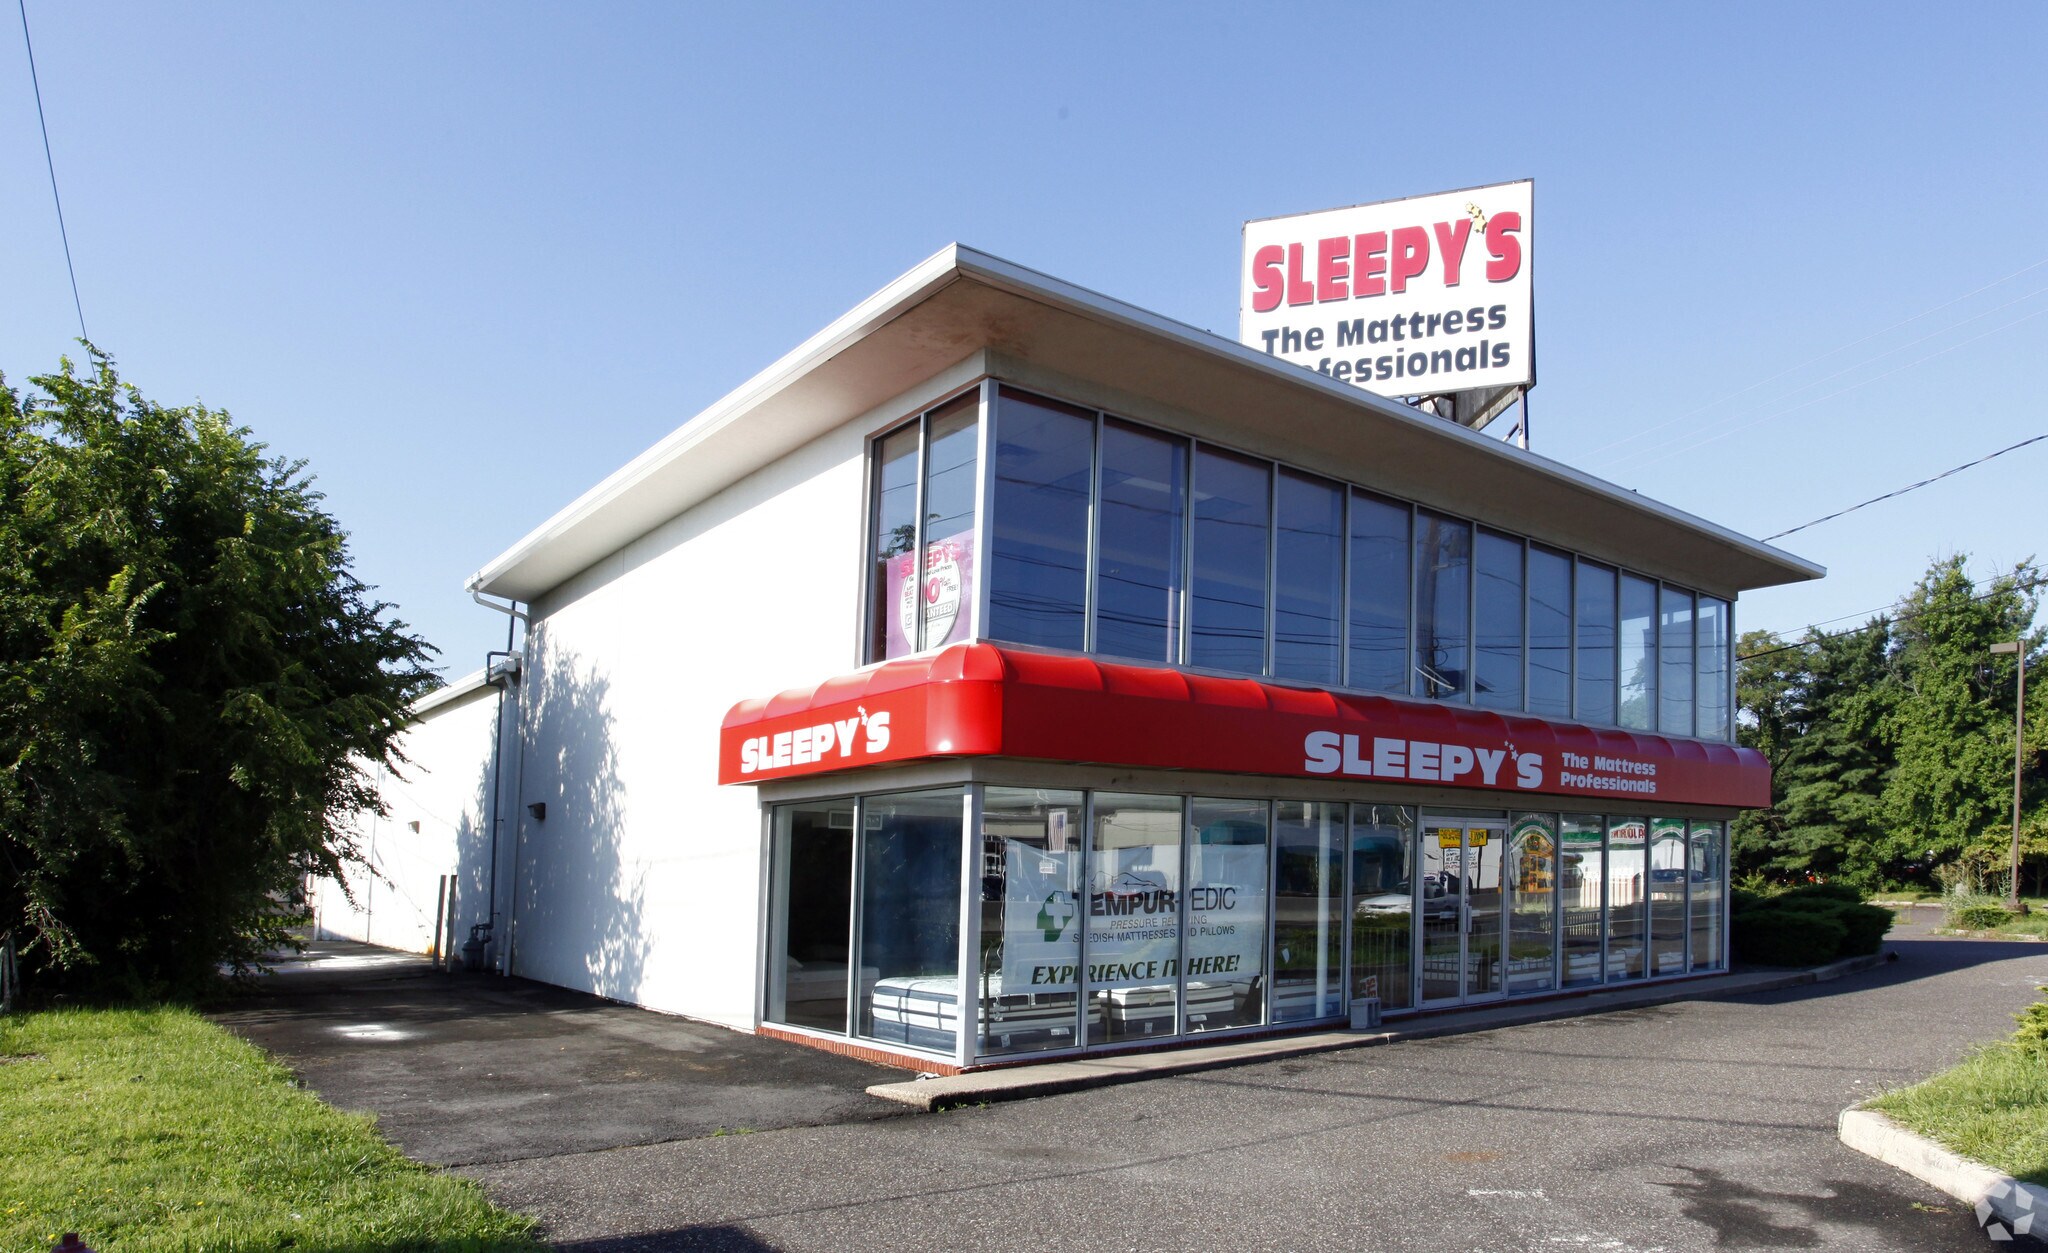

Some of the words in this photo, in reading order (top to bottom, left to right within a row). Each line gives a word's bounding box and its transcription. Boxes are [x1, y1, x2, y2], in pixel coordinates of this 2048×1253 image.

[1252, 203, 1521, 313] SLEEPY'S
[1262, 325, 1324, 355] The
[1337, 304, 1506, 348] Mattress
[1301, 340, 1510, 383] fessionals
[741, 705, 890, 774] SLEEPY'S
[1304, 731, 1543, 789] SLEEPY'S
[1561, 752, 1588, 769] The
[1594, 756, 1656, 776] Mattress
[1560, 771, 1656, 793] Professionals
[1072, 887, 1236, 917] EMPUR-EDIC
[1072, 931, 1114, 943] SEDISH
[1117, 929, 1176, 942] MATTRESSES
[1200, 925, 1235, 936] PILLOWS
[1110, 917, 1158, 930] PRESSURE
[1161, 915, 1207, 928] RELING
[1162, 959, 1178, 978] IT
[1187, 954, 1240, 976] HERE!
